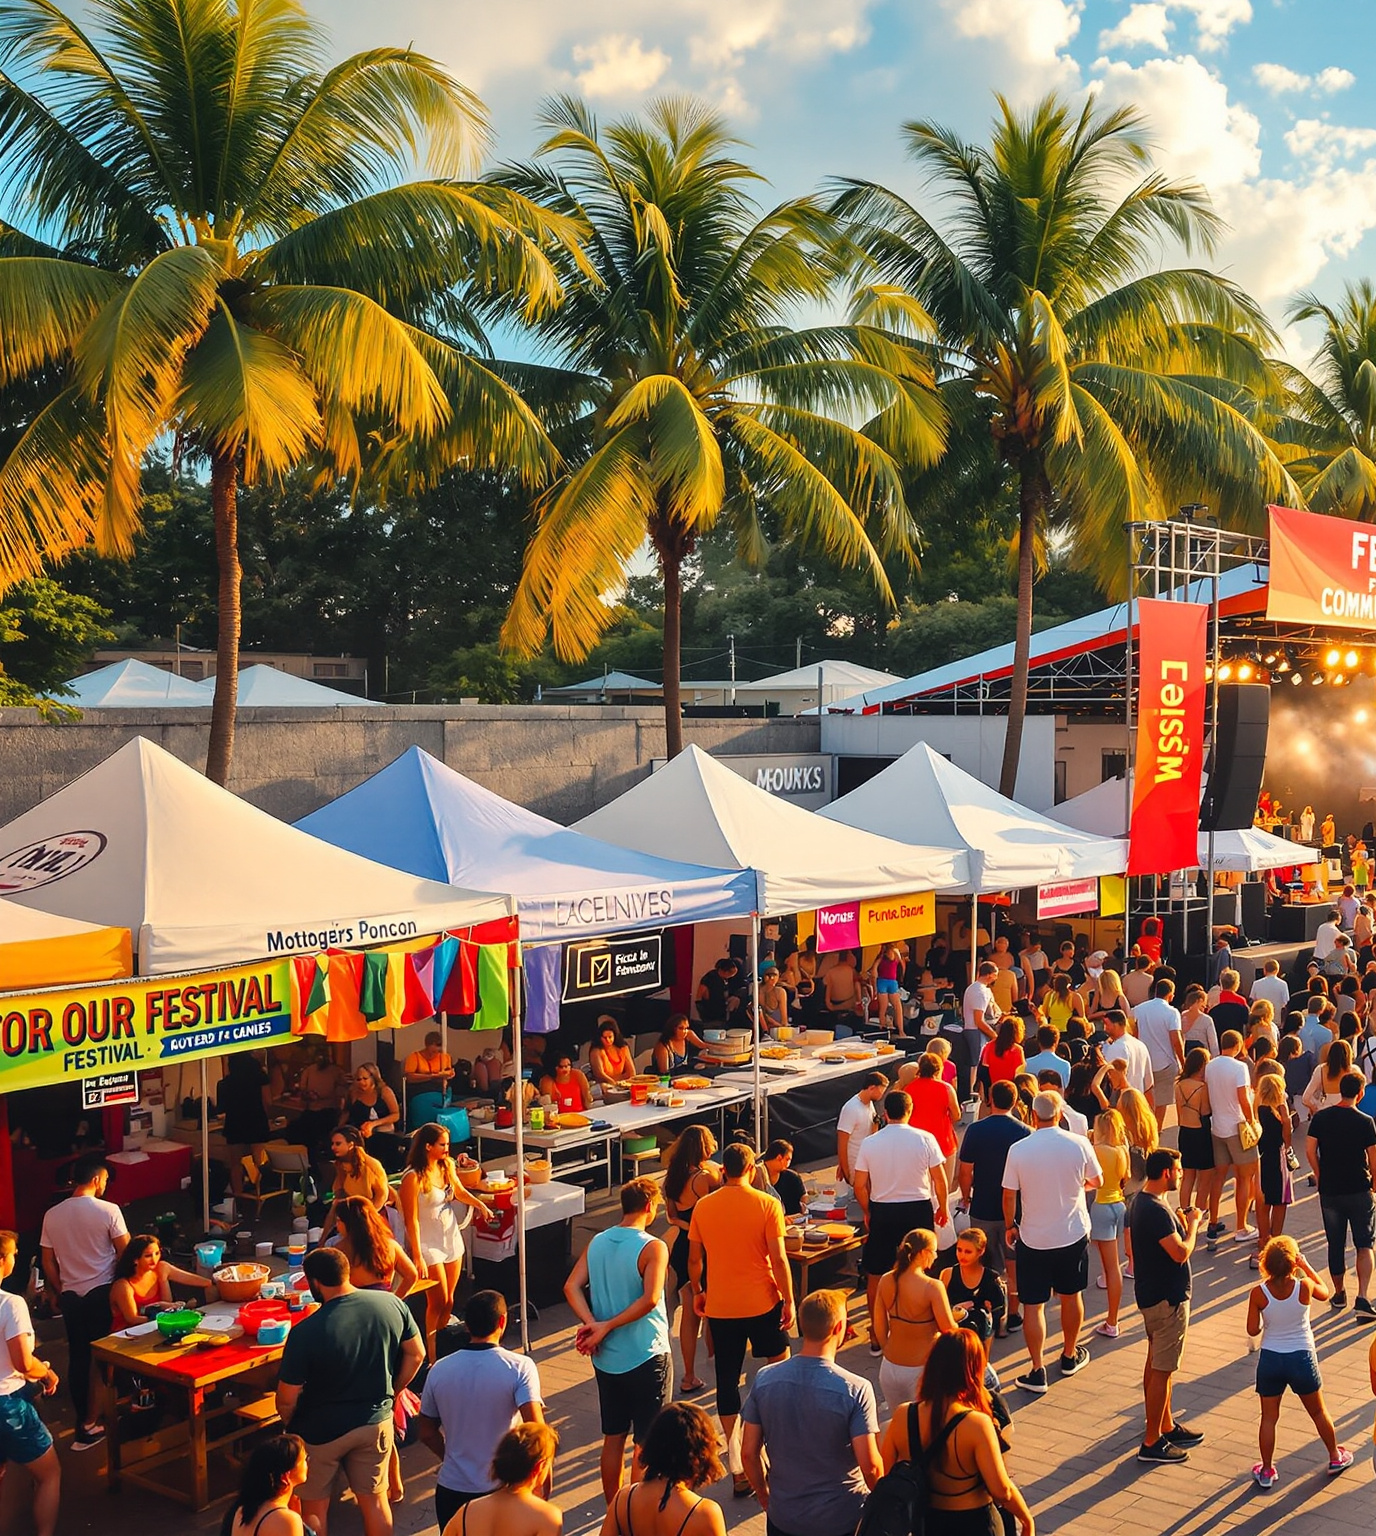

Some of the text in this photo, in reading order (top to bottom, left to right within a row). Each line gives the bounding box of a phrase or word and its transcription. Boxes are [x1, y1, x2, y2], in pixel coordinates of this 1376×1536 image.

[359, 920, 417, 940] Poncon
[0, 974, 282, 1058] OR OUR FESTIVAL
[64, 1041, 144, 1072] FESTIVAL
